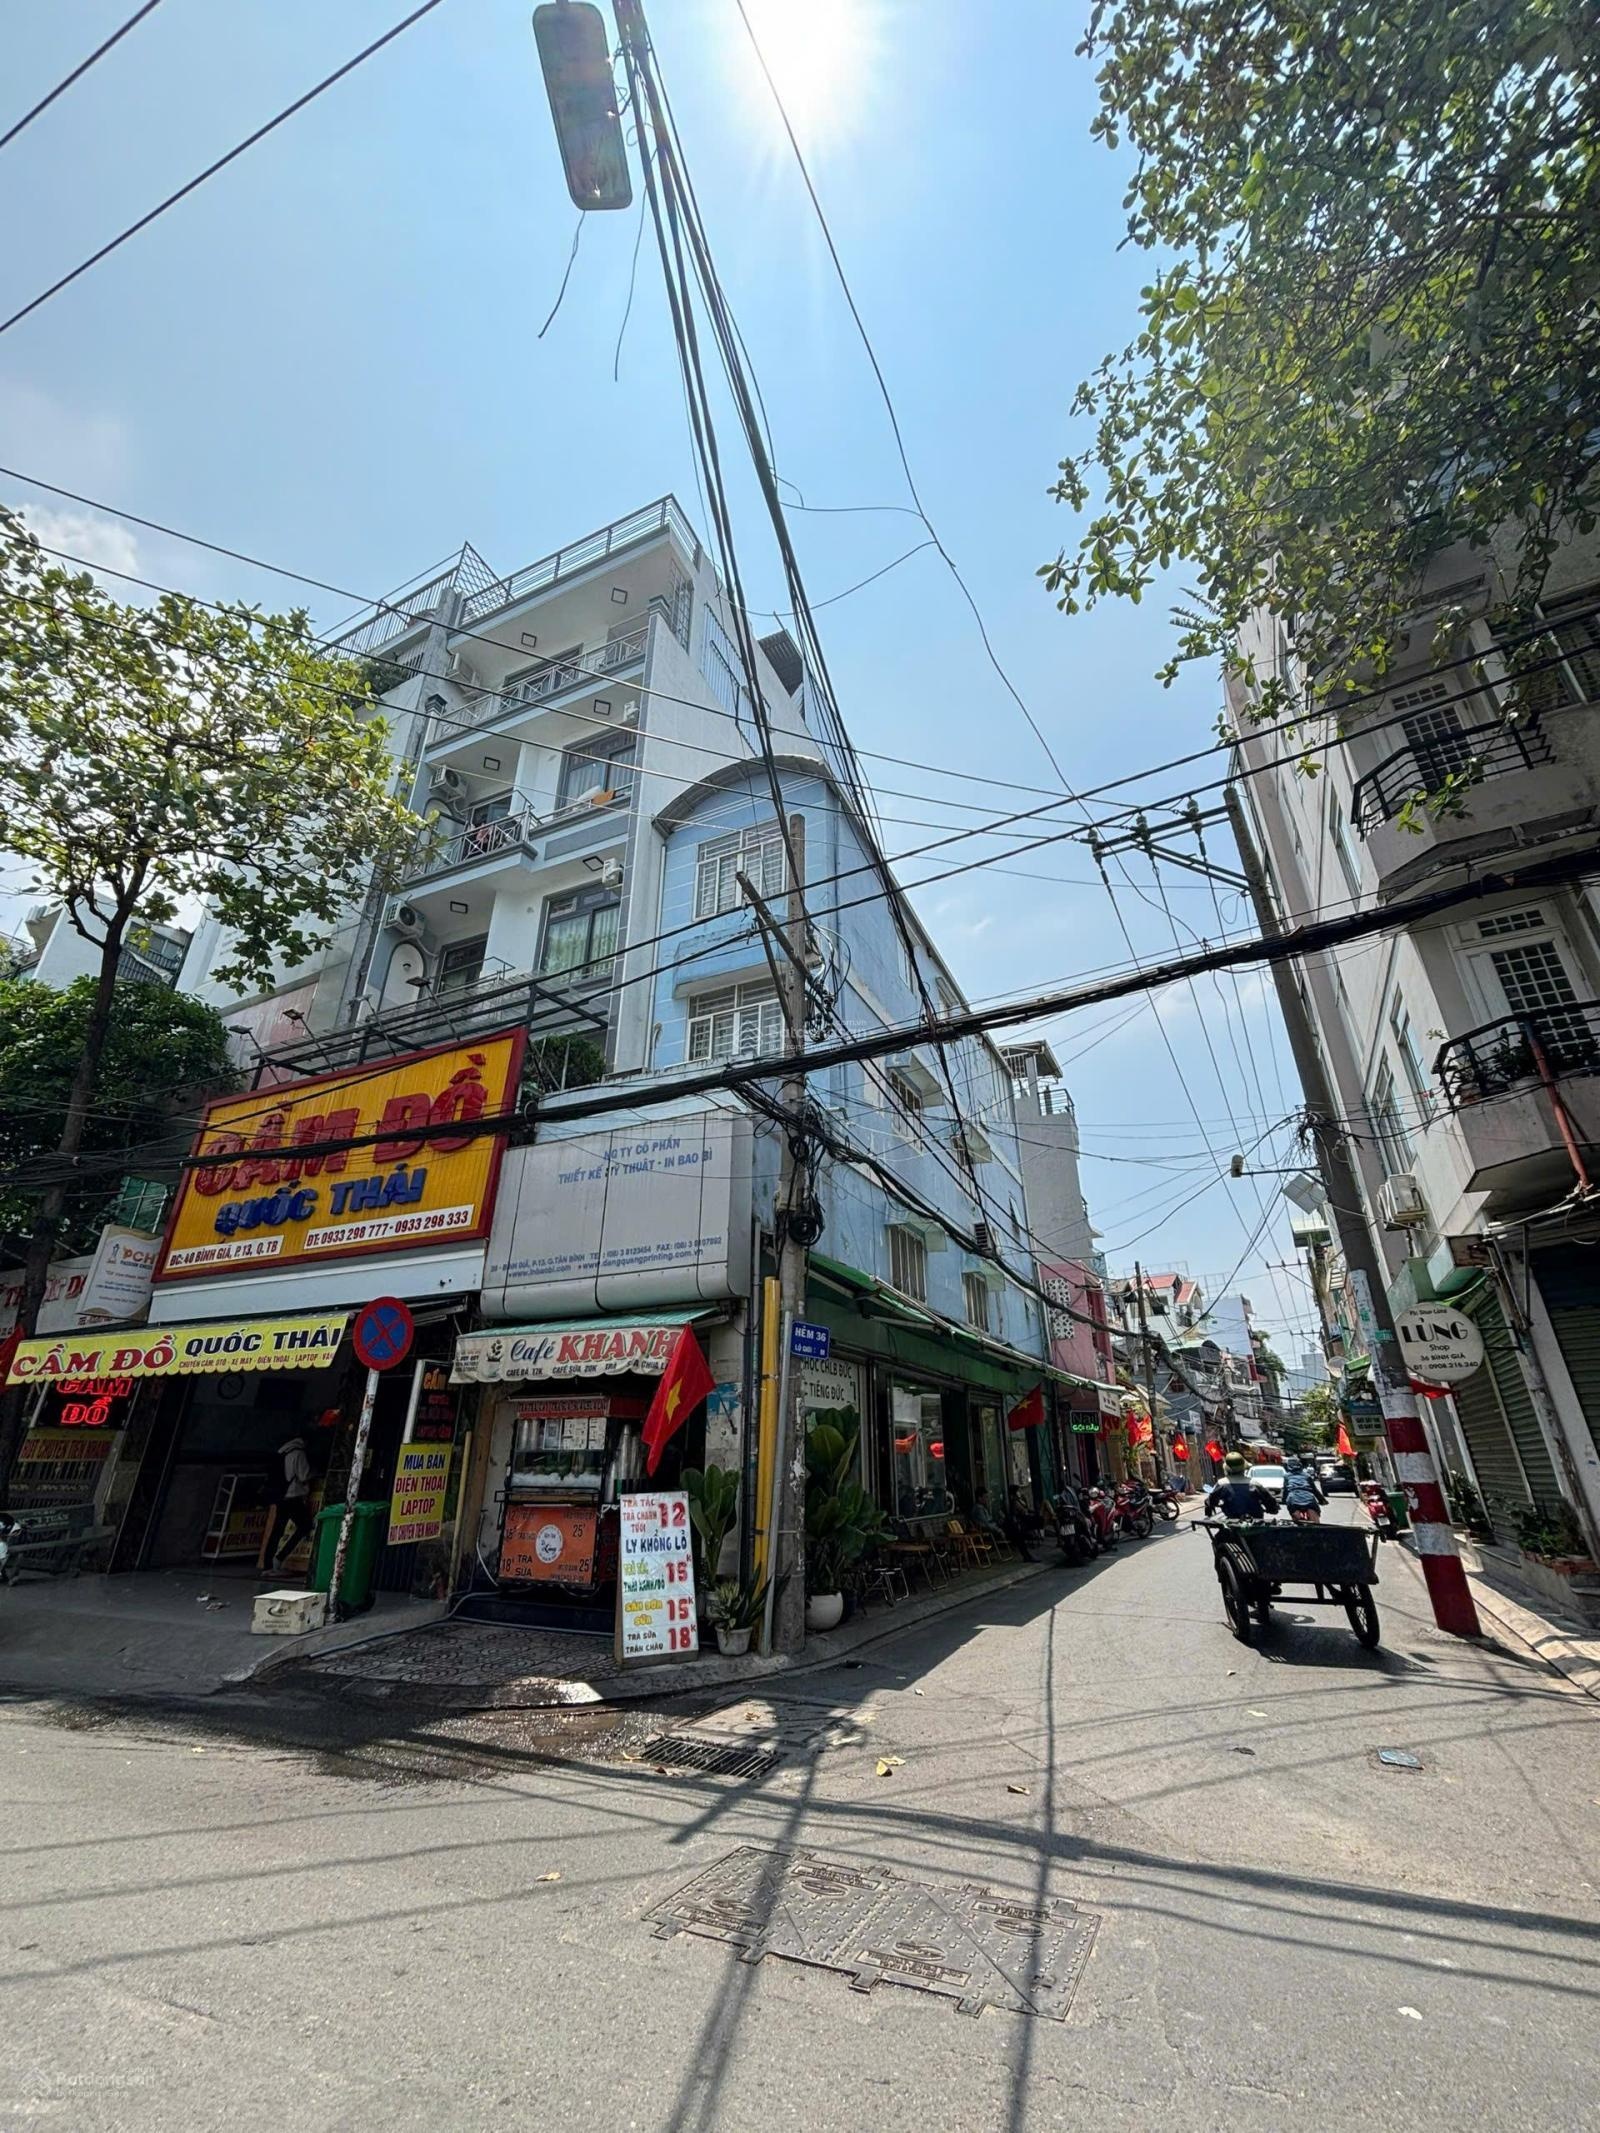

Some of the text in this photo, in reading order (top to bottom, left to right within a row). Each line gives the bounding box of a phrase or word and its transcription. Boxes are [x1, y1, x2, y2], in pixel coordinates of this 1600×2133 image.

[620, 1146, 633, 1157] TY
[559, 1167, 585, 1185] THIẾT
[588, 1162, 602, 1179] KẾ
[623, 1158, 655, 1174] THUẬT
[664, 1157, 675, 1167] IN
[678, 1153, 699, 1166] BAO
[216, 1163, 427, 1236] QUỐC THÁI
[321, 1232, 345, 1245] 0933
[346, 1228, 365, 1240] 298
[368, 1223, 389, 1237] 777
[395, 1218, 421, 1233] 0933
[423, 1214, 445, 1229] 298
[447, 1211, 468, 1225] 333
[195, 1248, 216, 1263] BÌNH
[267, 1241, 278, 1252] TB
[185, 1325, 342, 1357] QUỐC THÁI
[795, 1325, 826, 1342] HẺM 36
[12, 1334, 174, 1377] CẦM ĐỒ
[295, 1353, 318, 1362] LAPTOP
[510, 1337, 556, 1365] Café
[1429, 1344, 1450, 1352] Shop
[804, 1358, 819, 1374] HỌC
[809, 1380, 830, 1399] TIẾNG
[830, 1383, 845, 1401] ĐỨC
[403, 1451, 445, 1470] MUA BÁN
[395, 1474, 445, 1497] ĐIỆN THOẠI
[401, 1498, 435, 1516] LAPTOP
[626, 1539, 637, 1553] LY
